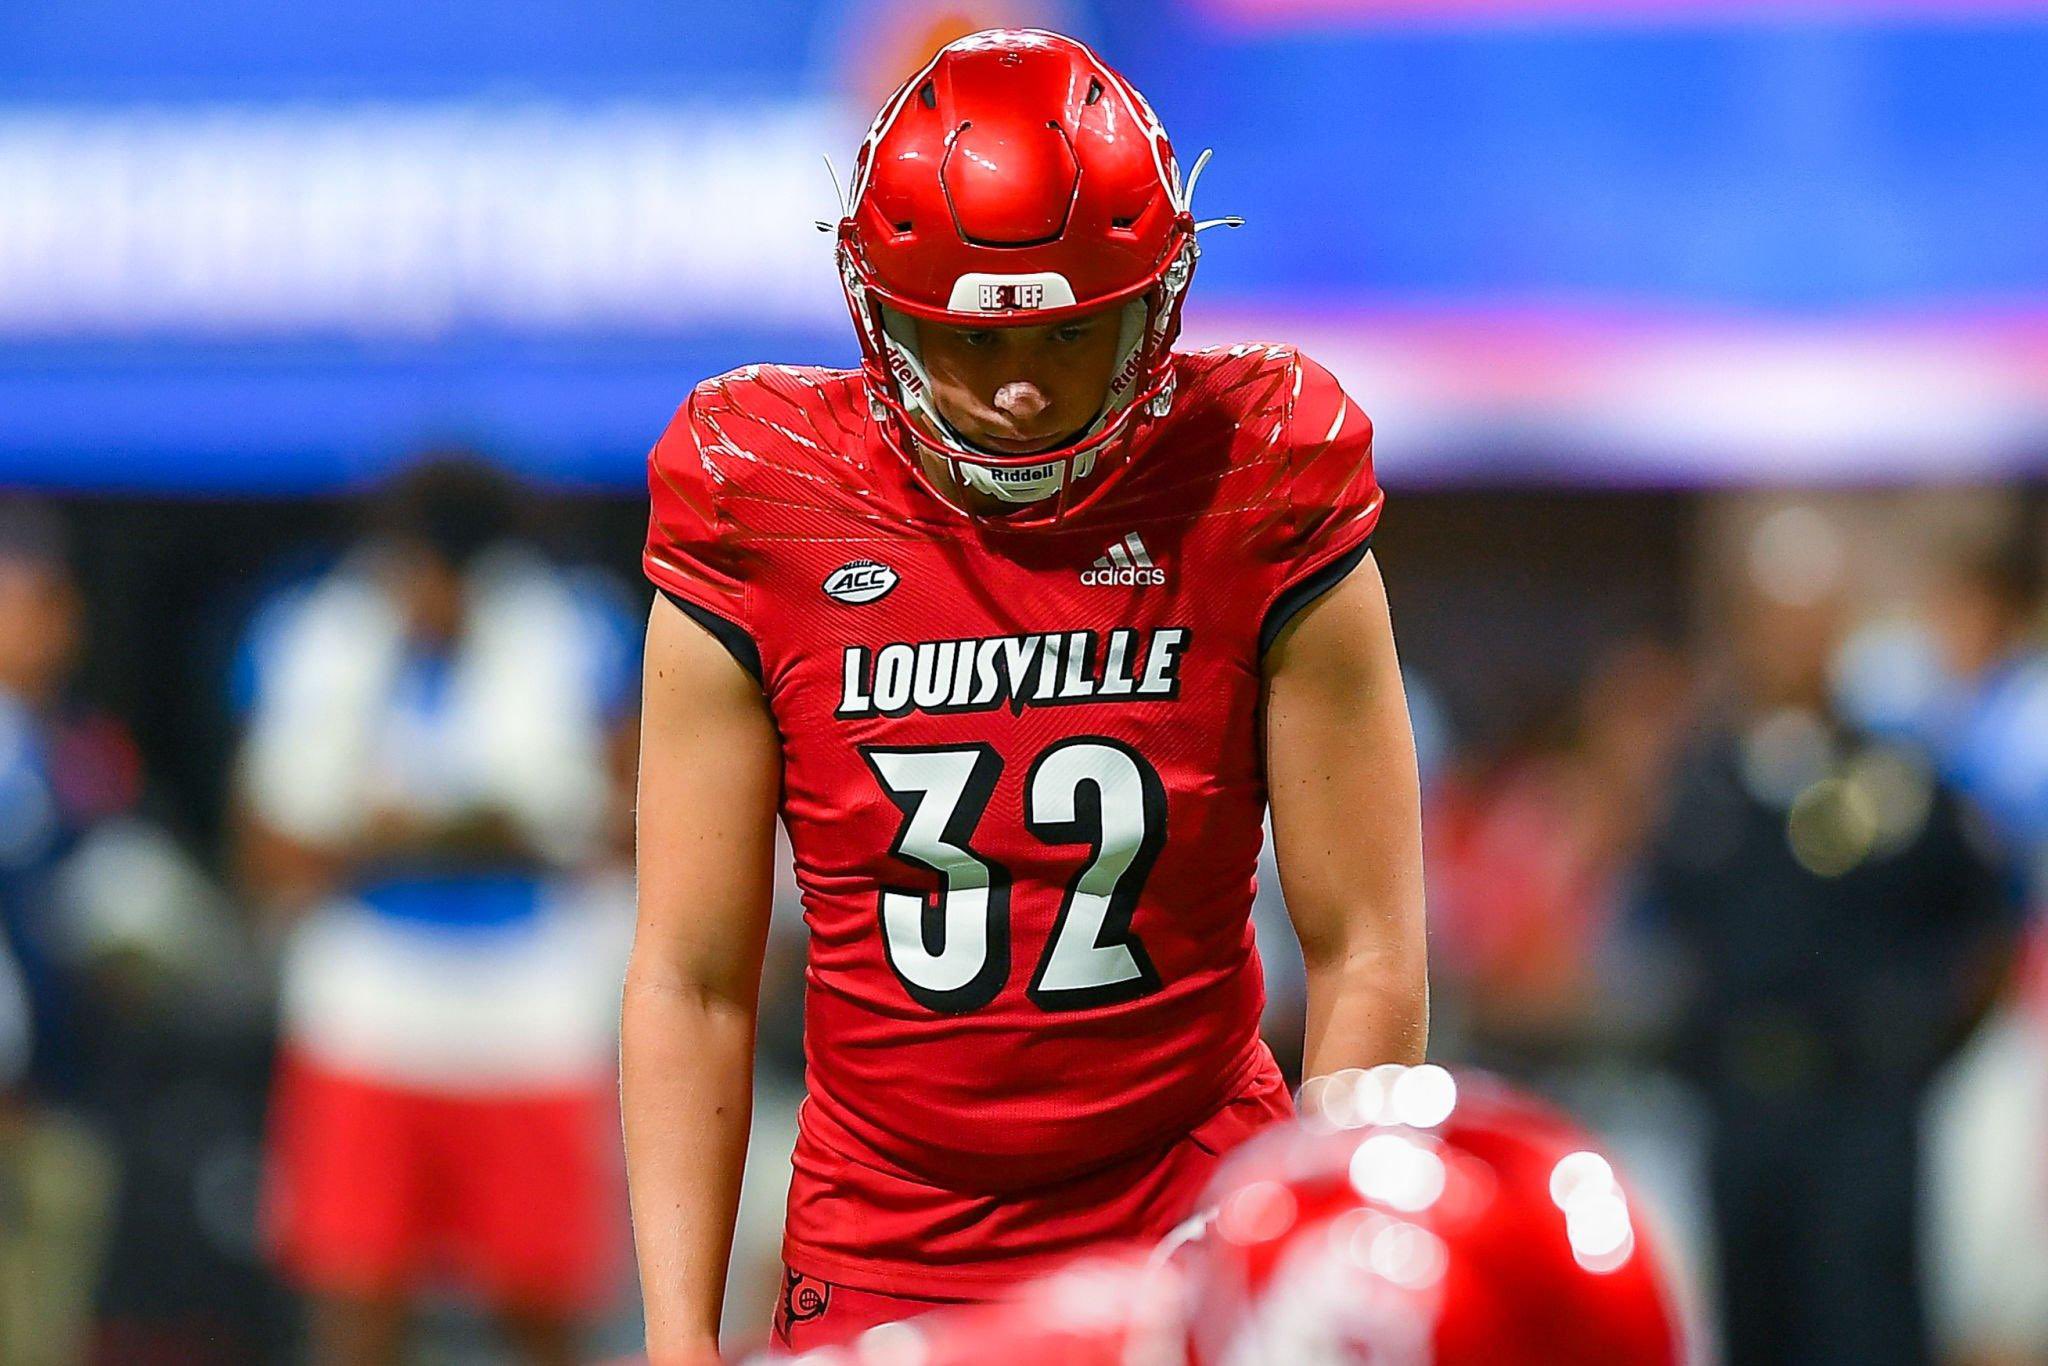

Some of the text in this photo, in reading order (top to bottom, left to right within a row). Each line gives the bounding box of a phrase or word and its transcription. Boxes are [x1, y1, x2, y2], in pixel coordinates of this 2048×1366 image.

[991, 464, 1054, 482] Riddell
[834, 567, 888, 590] ACC
[1080, 566, 1165, 586] adidas
[836, 628, 1190, 717] LOUISVILLE
[860, 737, 1167, 1011] 32
